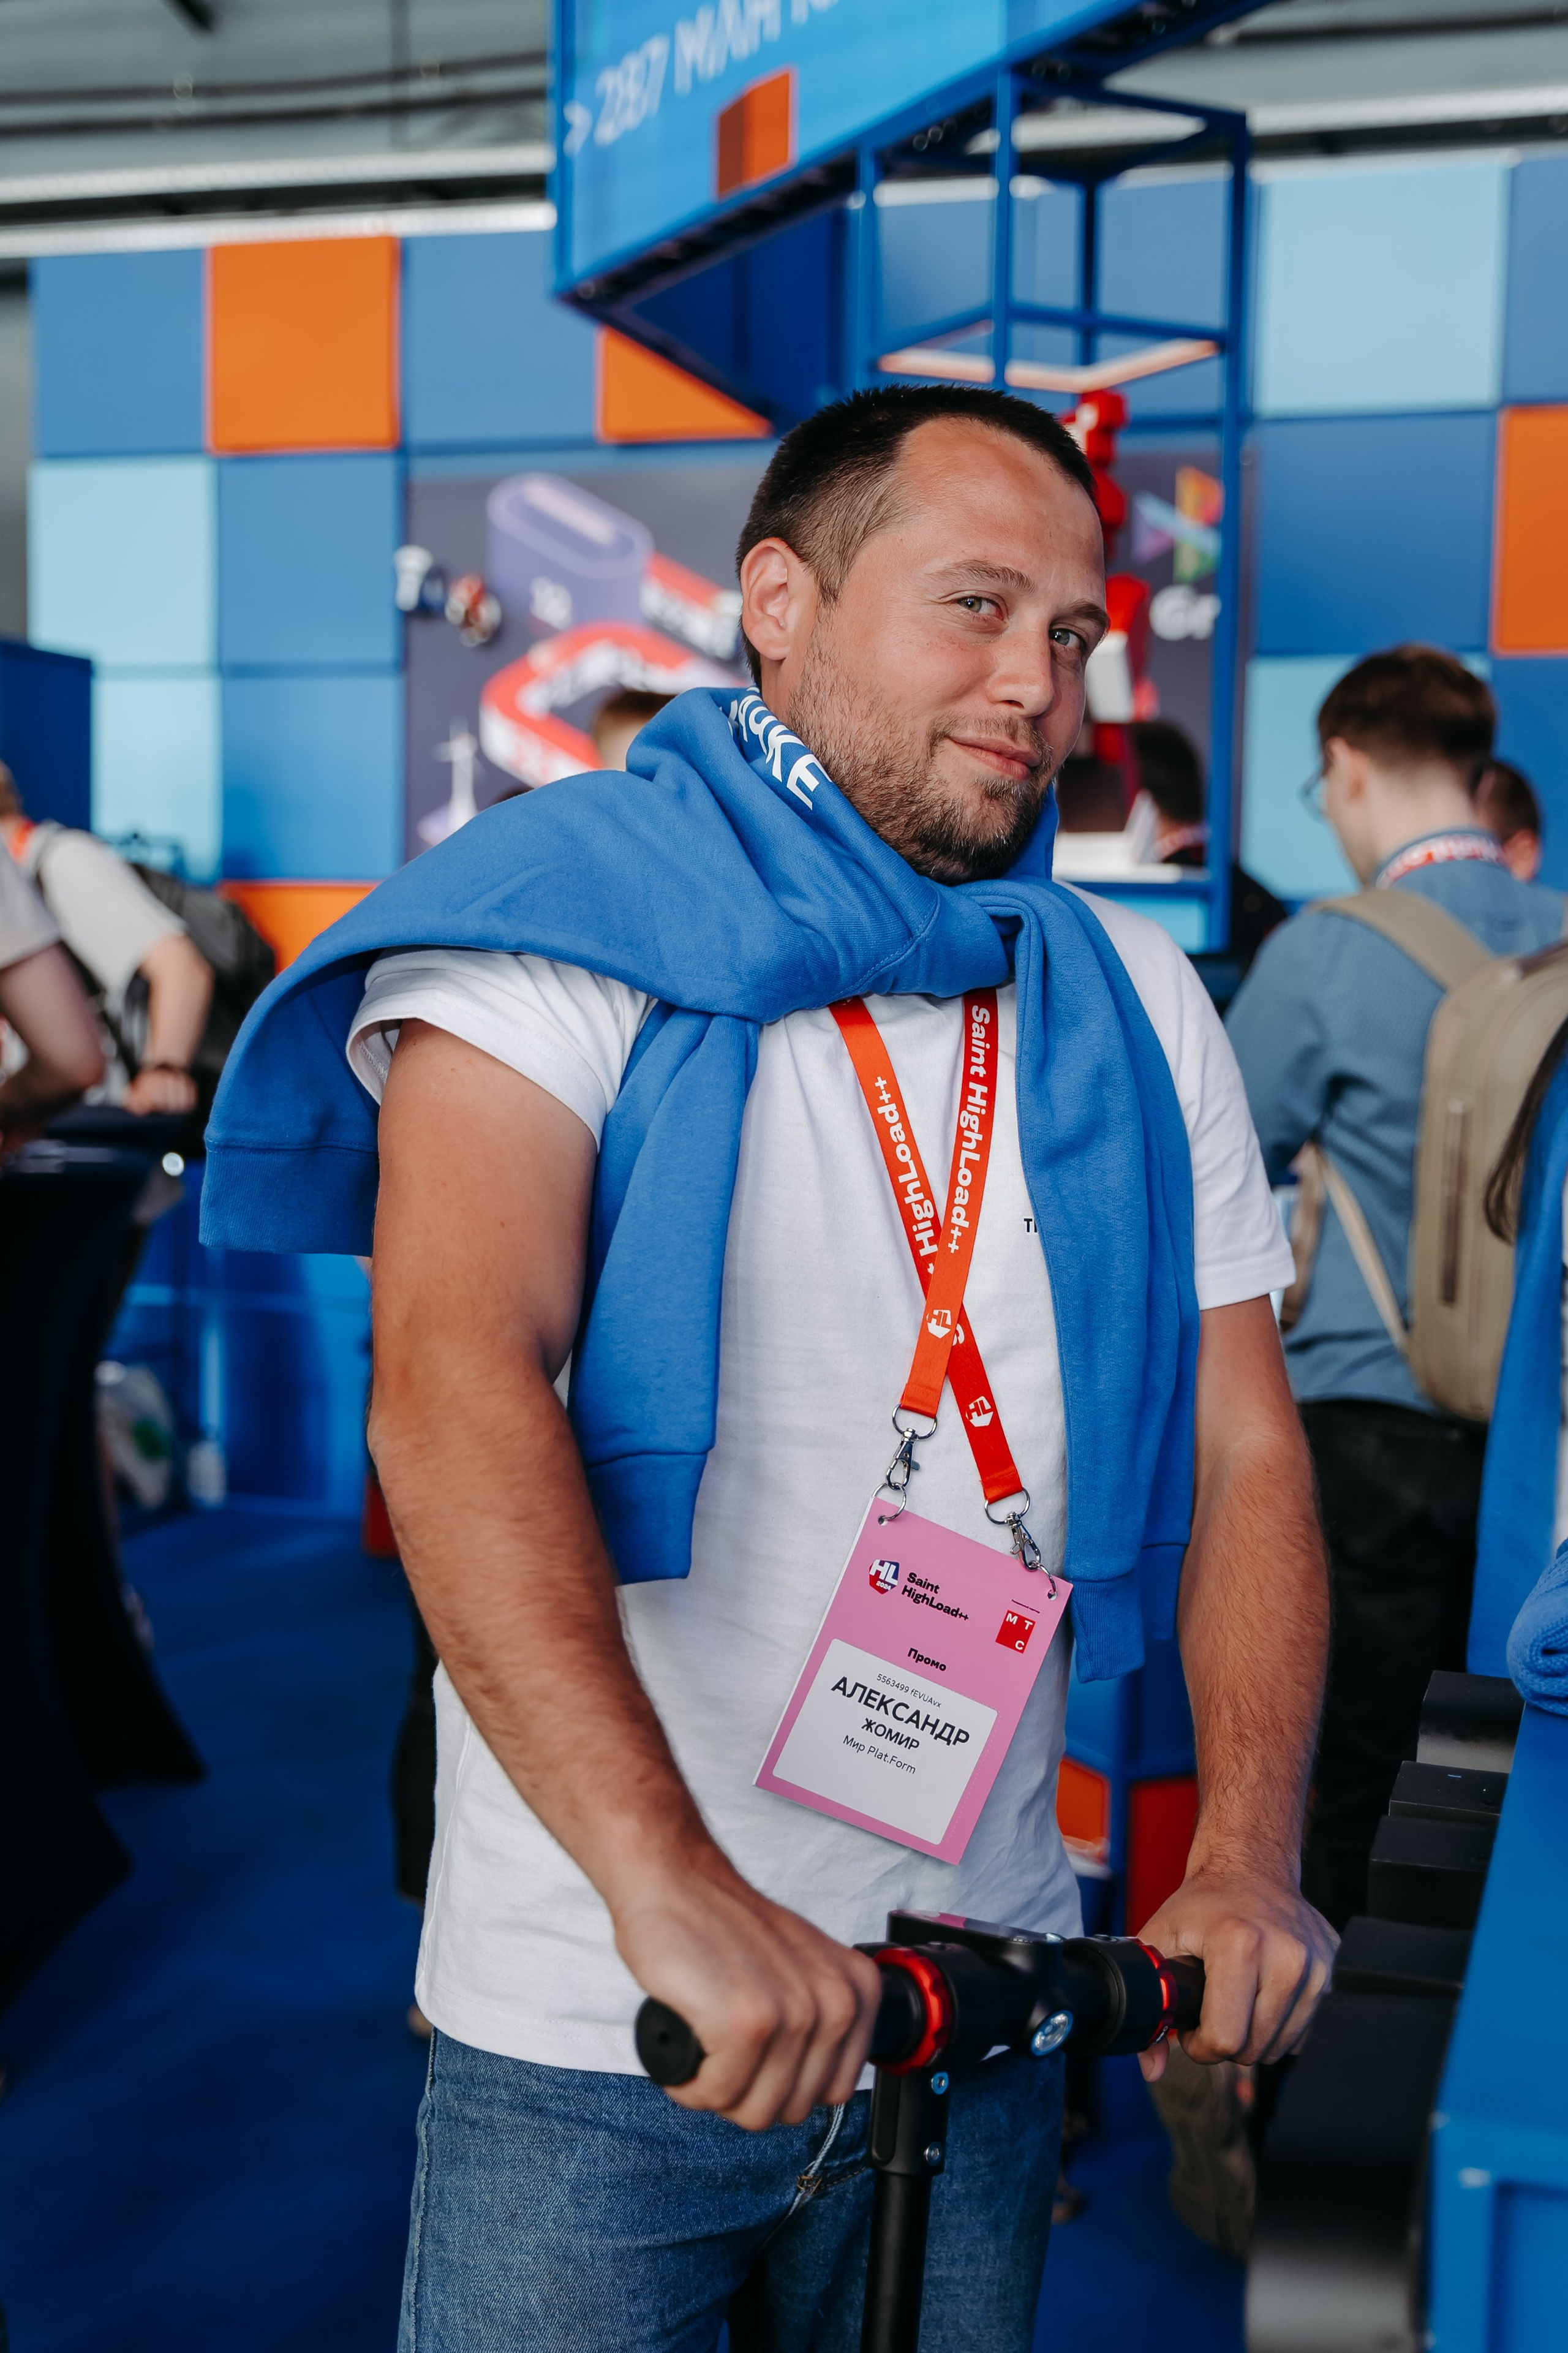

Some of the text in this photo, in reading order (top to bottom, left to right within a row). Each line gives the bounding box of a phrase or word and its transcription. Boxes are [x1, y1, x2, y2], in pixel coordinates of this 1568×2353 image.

[948, 1005, 990, 1253] Saint HighLoad++
[875, 1076, 938, 1256] HighLoad++
[869, 1559, 898, 1585] HL
[876, 1581, 891, 1590] 2024
[907, 1572, 940, 1594] Saint
[901, 1585, 969, 1621] HighLoad++
[907, 1647, 946, 1671] Промо
[876, 1674, 910, 1693] 5563499
[831, 1676, 970, 1746] АЛЕКСАНДР
[861, 1718, 920, 1750] ЖОМИР
[843, 1735, 916, 1774] Мир Plat.Form
